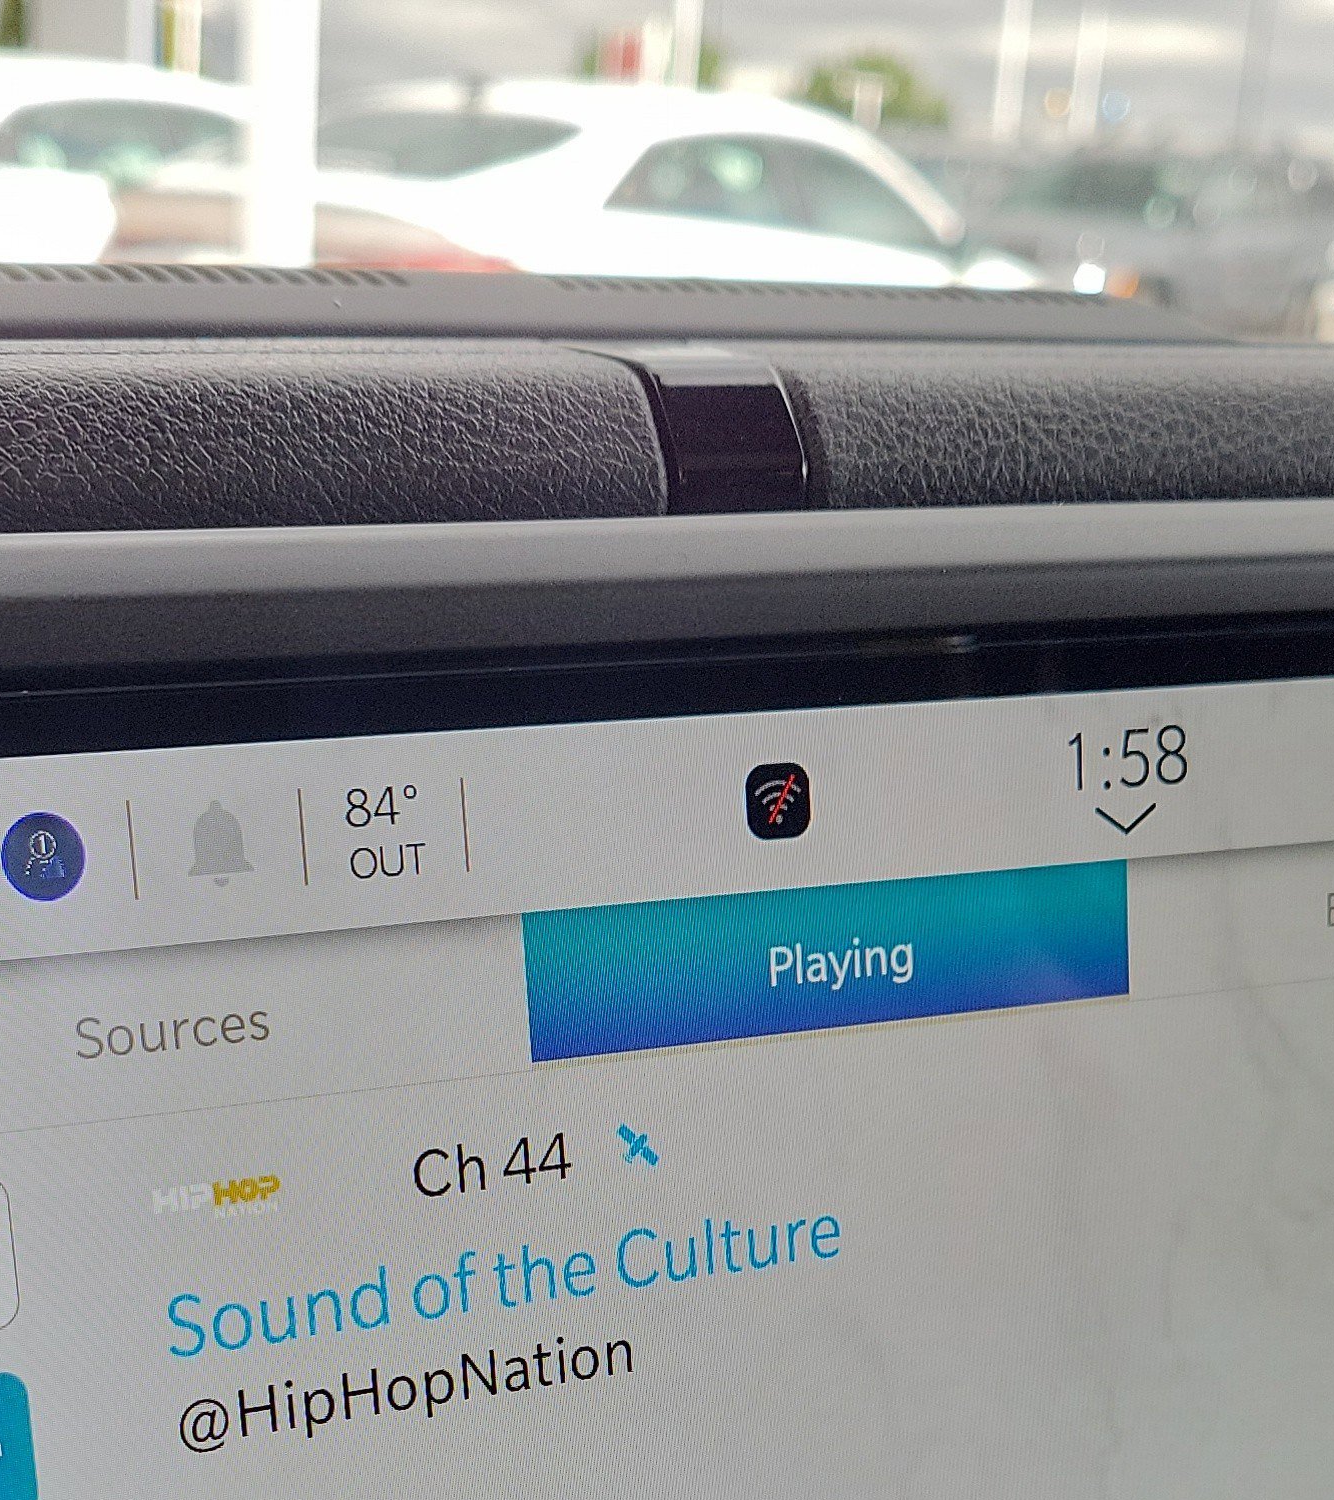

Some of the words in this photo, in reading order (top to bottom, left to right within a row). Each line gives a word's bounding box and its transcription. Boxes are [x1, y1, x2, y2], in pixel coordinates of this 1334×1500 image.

[1067, 723, 1188, 792] 1:58
[344, 784, 419, 828] 84°
[349, 842, 426, 880] OUT
[768, 936, 914, 990] Playing
[75, 1008, 271, 1060] Sources
[413, 1143, 487, 1199] Ch
[503, 1131, 573, 1184] 44
[168, 1265, 390, 1358] Sound
[412, 1250, 479, 1322] of
[493, 1243, 597, 1309] the
[615, 1212, 842, 1289] Culture
[178, 1334, 635, 1454] @HipHopNation
